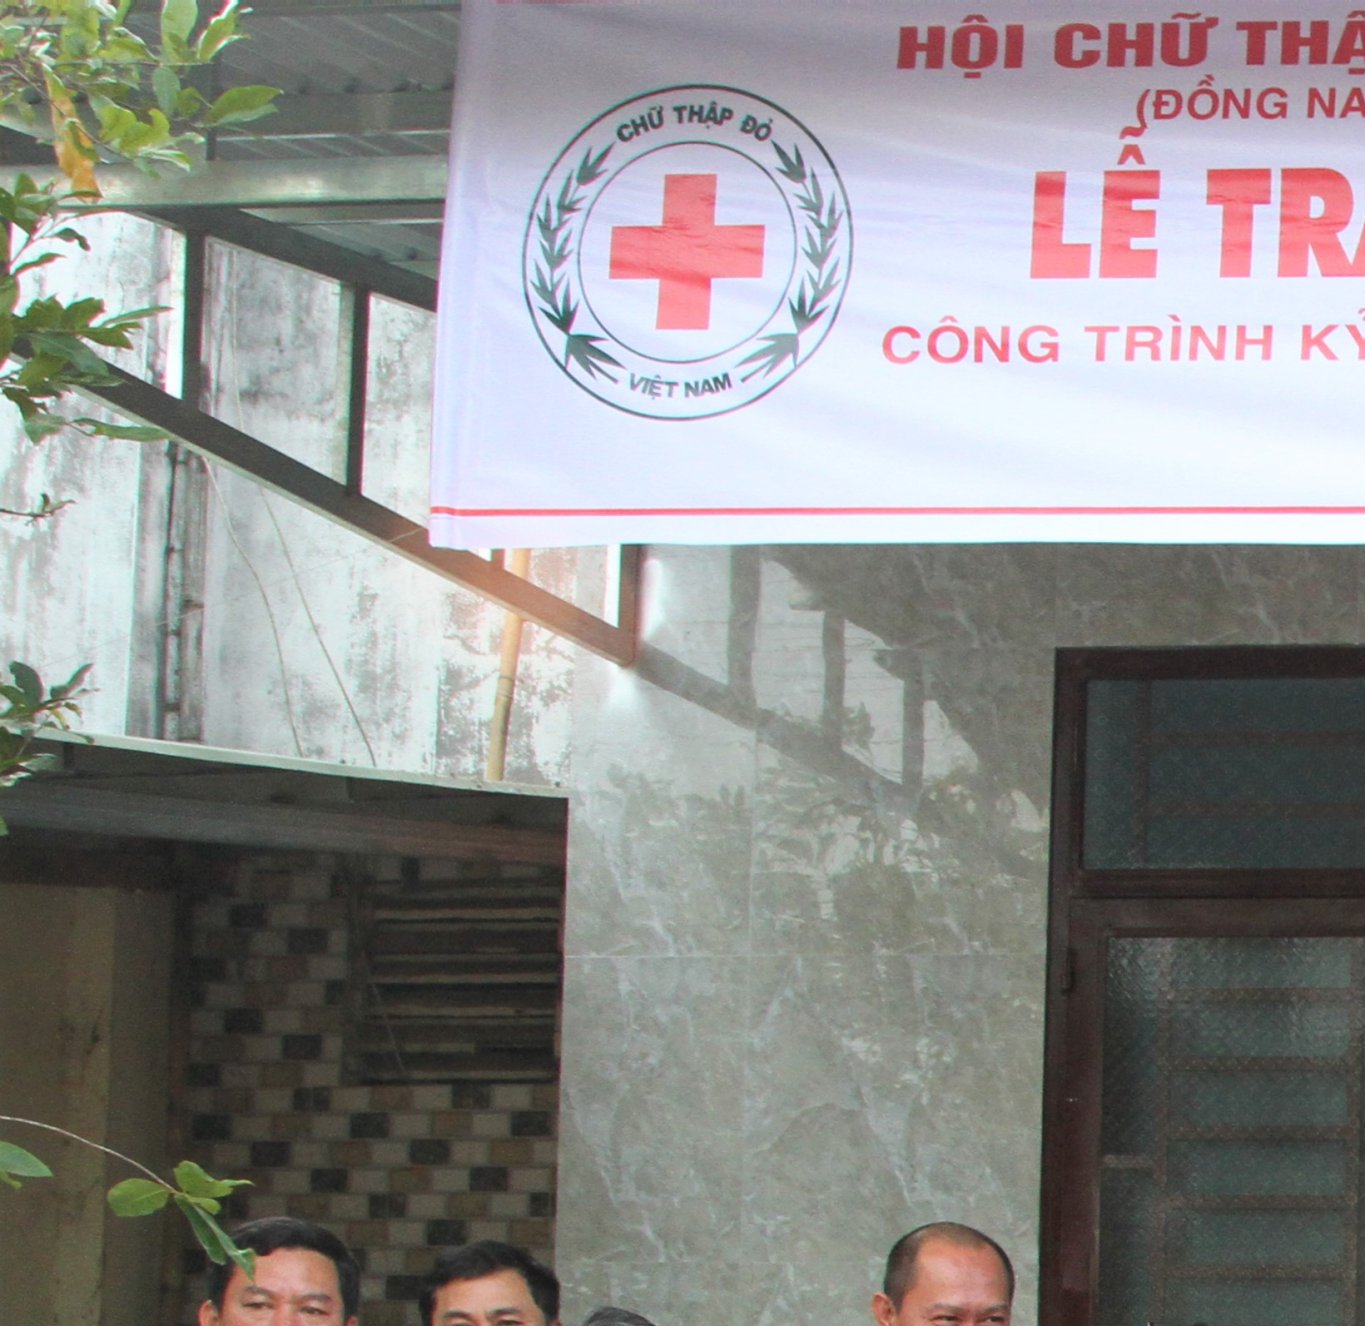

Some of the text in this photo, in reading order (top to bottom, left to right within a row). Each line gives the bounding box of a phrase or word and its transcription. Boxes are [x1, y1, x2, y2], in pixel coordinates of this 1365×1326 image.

[898, 15, 1025, 79] HỘI
[1055, 12, 1220, 69] CHỮ
[617, 101, 773, 142] CHỮ THẬP ĐỎ
[1136, 75, 1289, 128] (ĐỒNG
[1031, 125, 1162, 279] LỄ
[883, 316, 1060, 364] CÔNG
[1085, 315, 1274, 362] TRÌNH
[629, 372, 732, 400] VIỆT NAM
